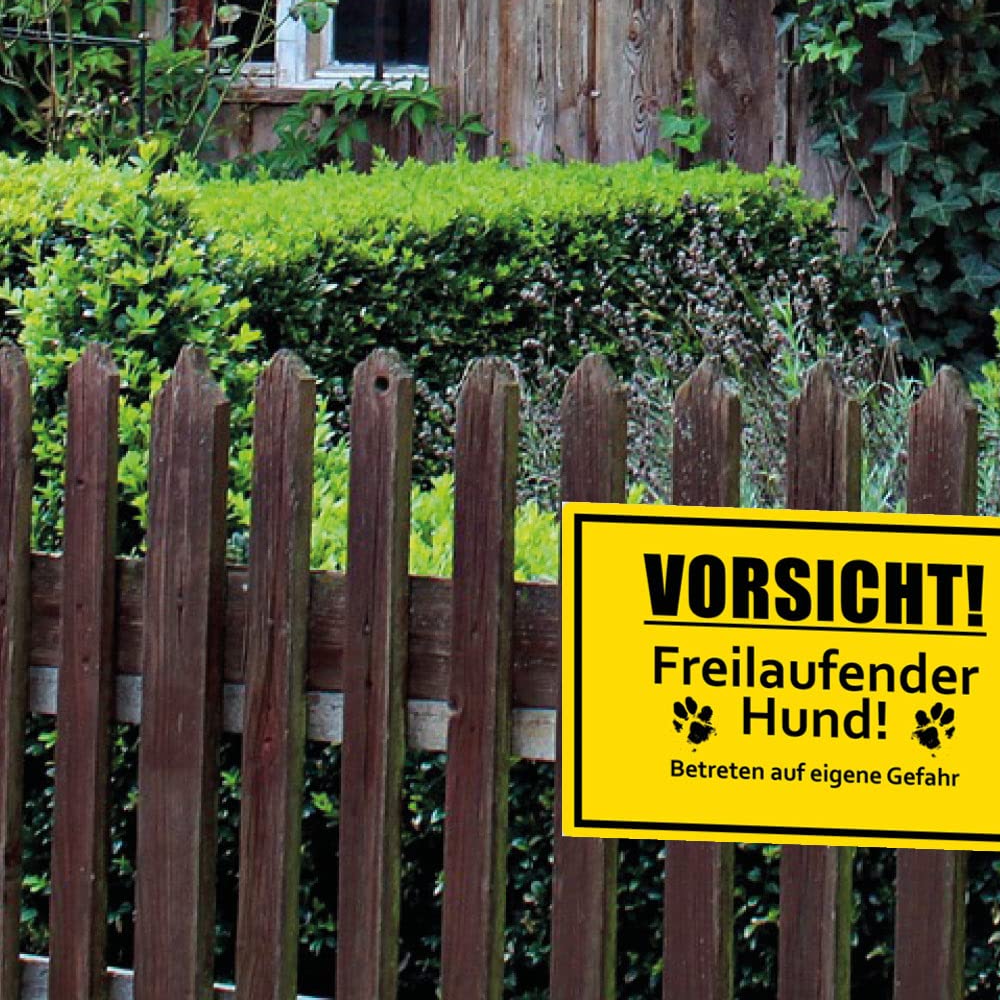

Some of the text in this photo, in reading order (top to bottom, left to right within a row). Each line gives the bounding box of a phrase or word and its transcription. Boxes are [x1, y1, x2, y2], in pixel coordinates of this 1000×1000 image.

[643, 553, 986, 628] VORSICHT!
[653, 645, 980, 696] Freilaufender
[743, 696, 888, 740] Hund!
[670, 759, 960, 789] Betreten auf eigene Gefahr
